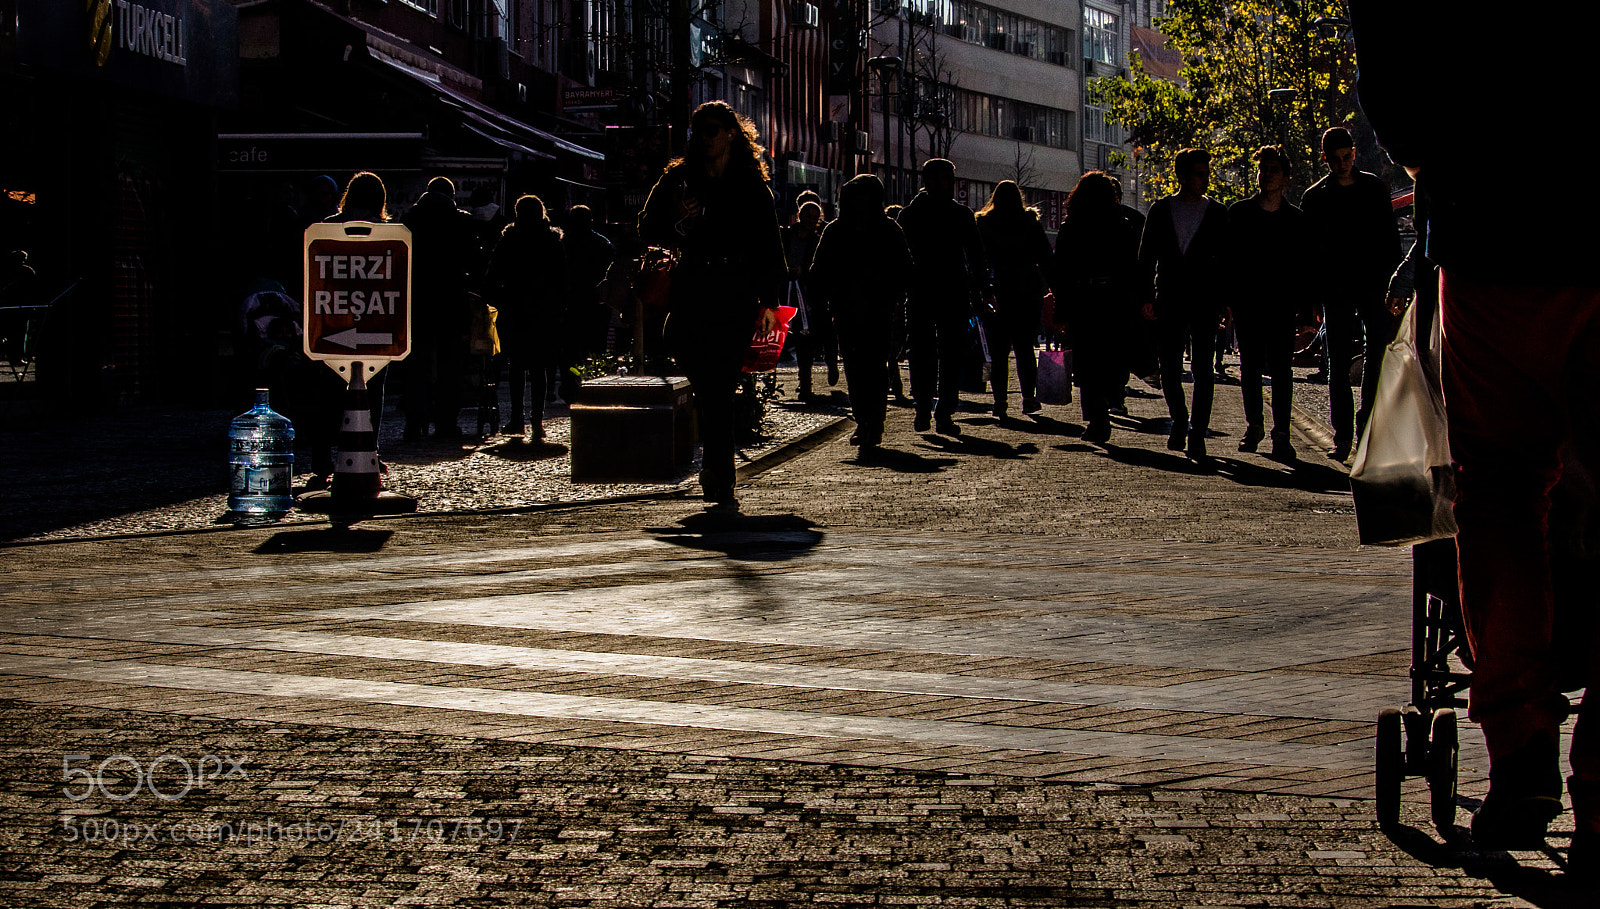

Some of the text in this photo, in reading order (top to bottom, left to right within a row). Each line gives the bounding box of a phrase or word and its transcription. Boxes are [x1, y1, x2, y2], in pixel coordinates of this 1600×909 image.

[117, 0, 187, 66] TURKCELL
[229, 147, 268, 162] cafe
[315, 250, 392, 279] TERZİ
[315, 290, 400, 321] REŞAT
